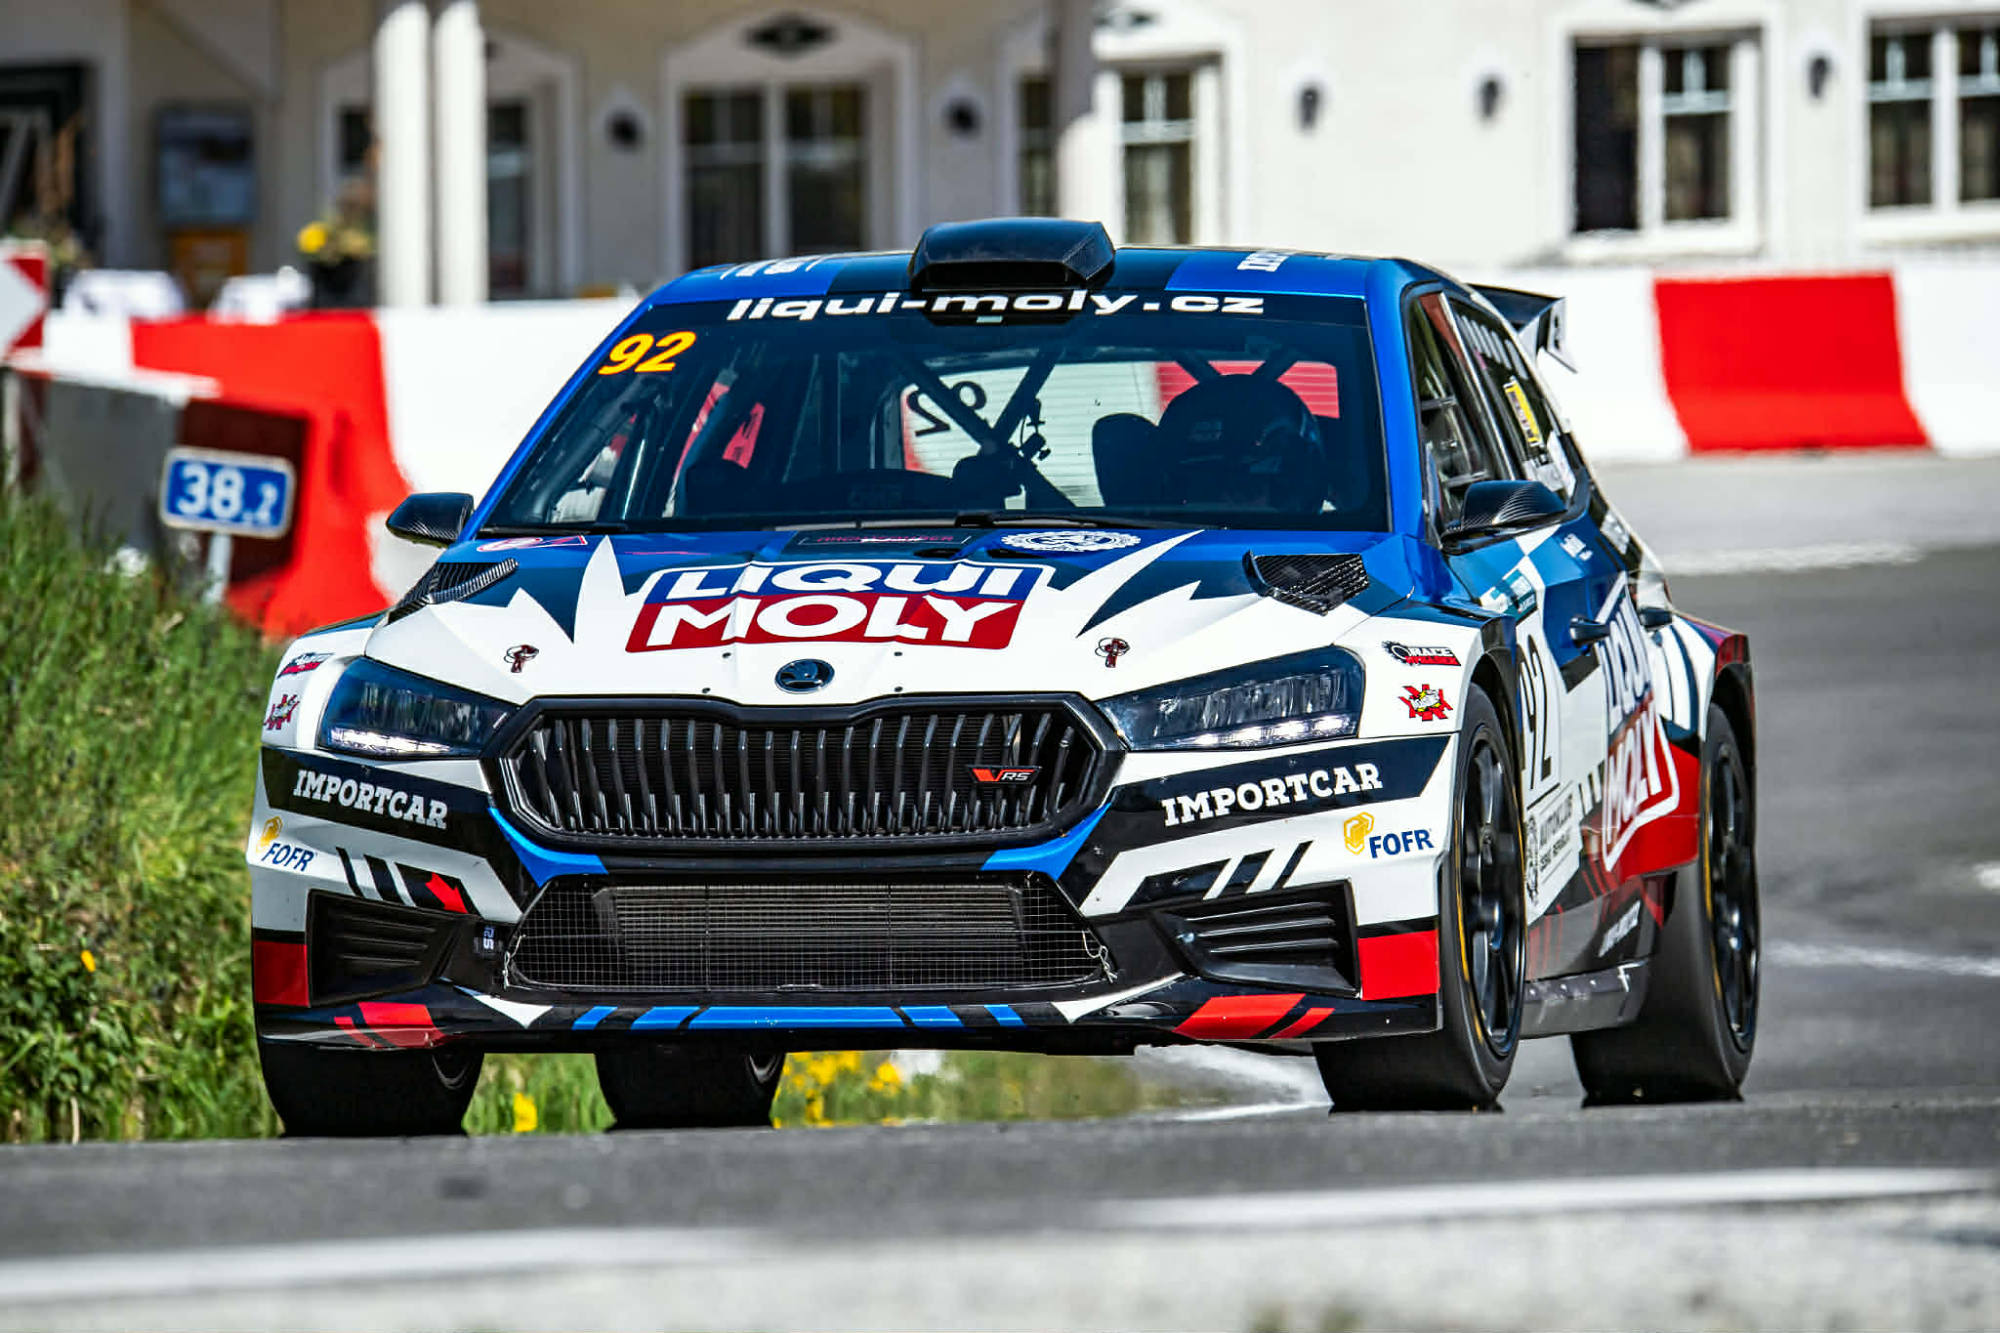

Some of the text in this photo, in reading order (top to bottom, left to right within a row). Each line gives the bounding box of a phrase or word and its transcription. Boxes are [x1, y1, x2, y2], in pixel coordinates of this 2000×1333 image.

[726, 290, 1264, 320] liqui-moly.cz
[597, 331, 696, 375] 92
[666, 562, 1022, 600] LIQUI
[646, 593, 1018, 646] MOLY
[293, 769, 449, 830] IMPORTCAR
[1162, 763, 1383, 827] IMPORTCAR
[260, 842, 316, 872] FOFR
[1368, 829, 1434, 859] FOFR
